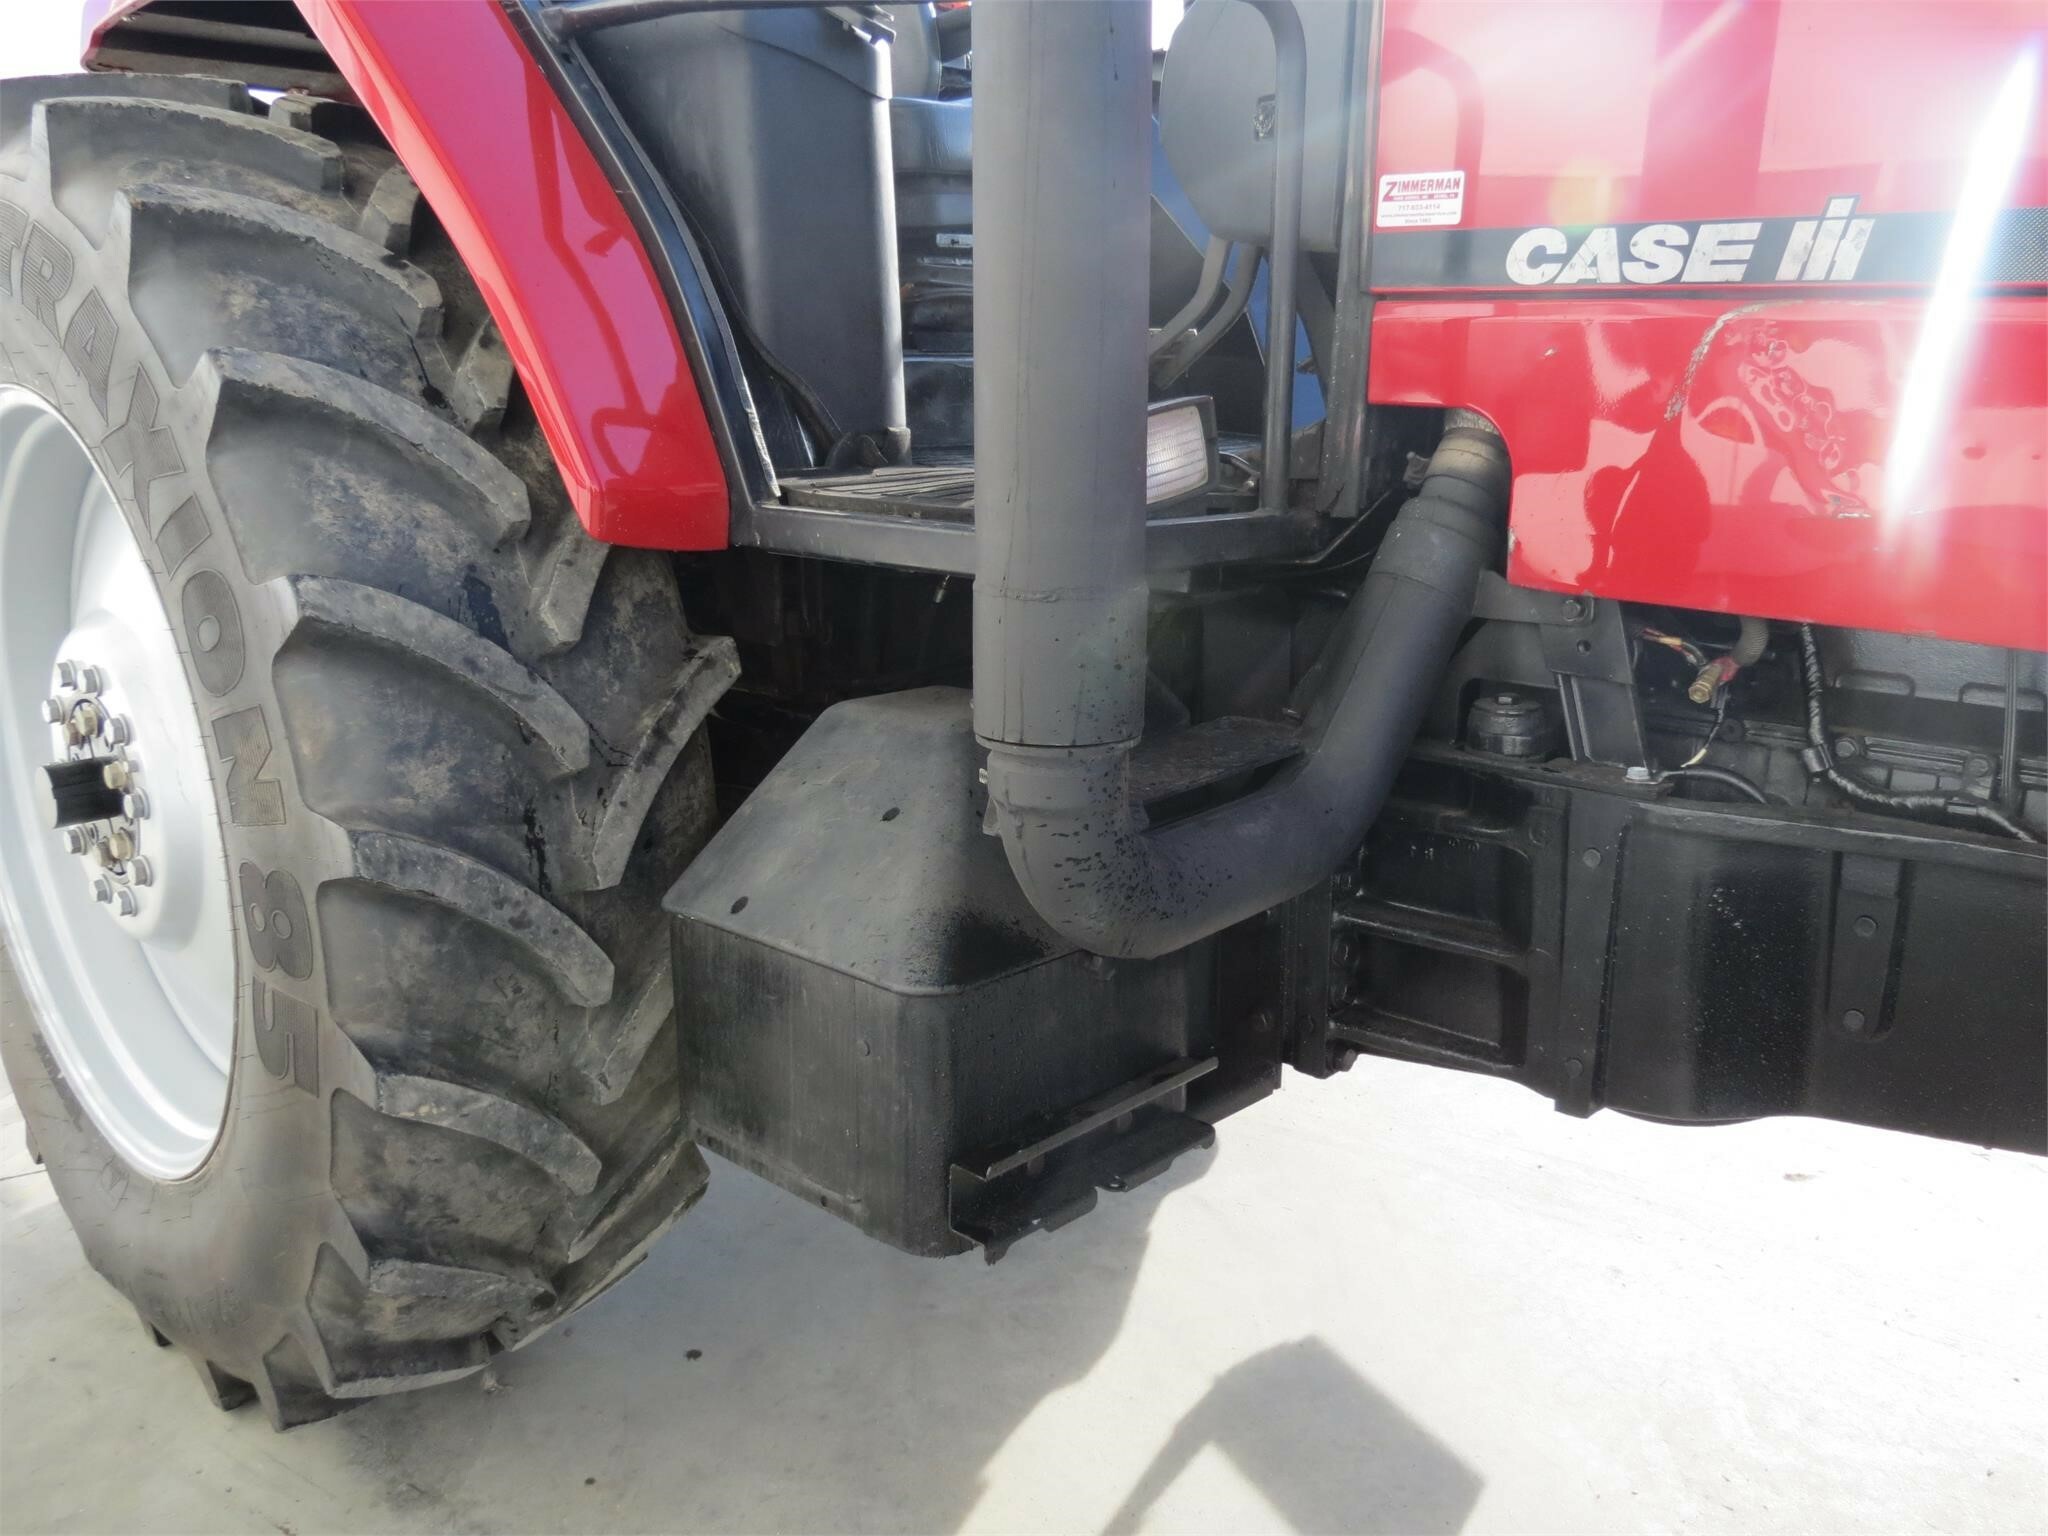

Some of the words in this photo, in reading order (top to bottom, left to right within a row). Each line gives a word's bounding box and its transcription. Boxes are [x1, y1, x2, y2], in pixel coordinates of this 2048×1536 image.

[1382, 177, 1461, 202] ZIMMERMAN
[1506, 223, 1763, 285] CASE
[238, 859, 320, 1099] 85
